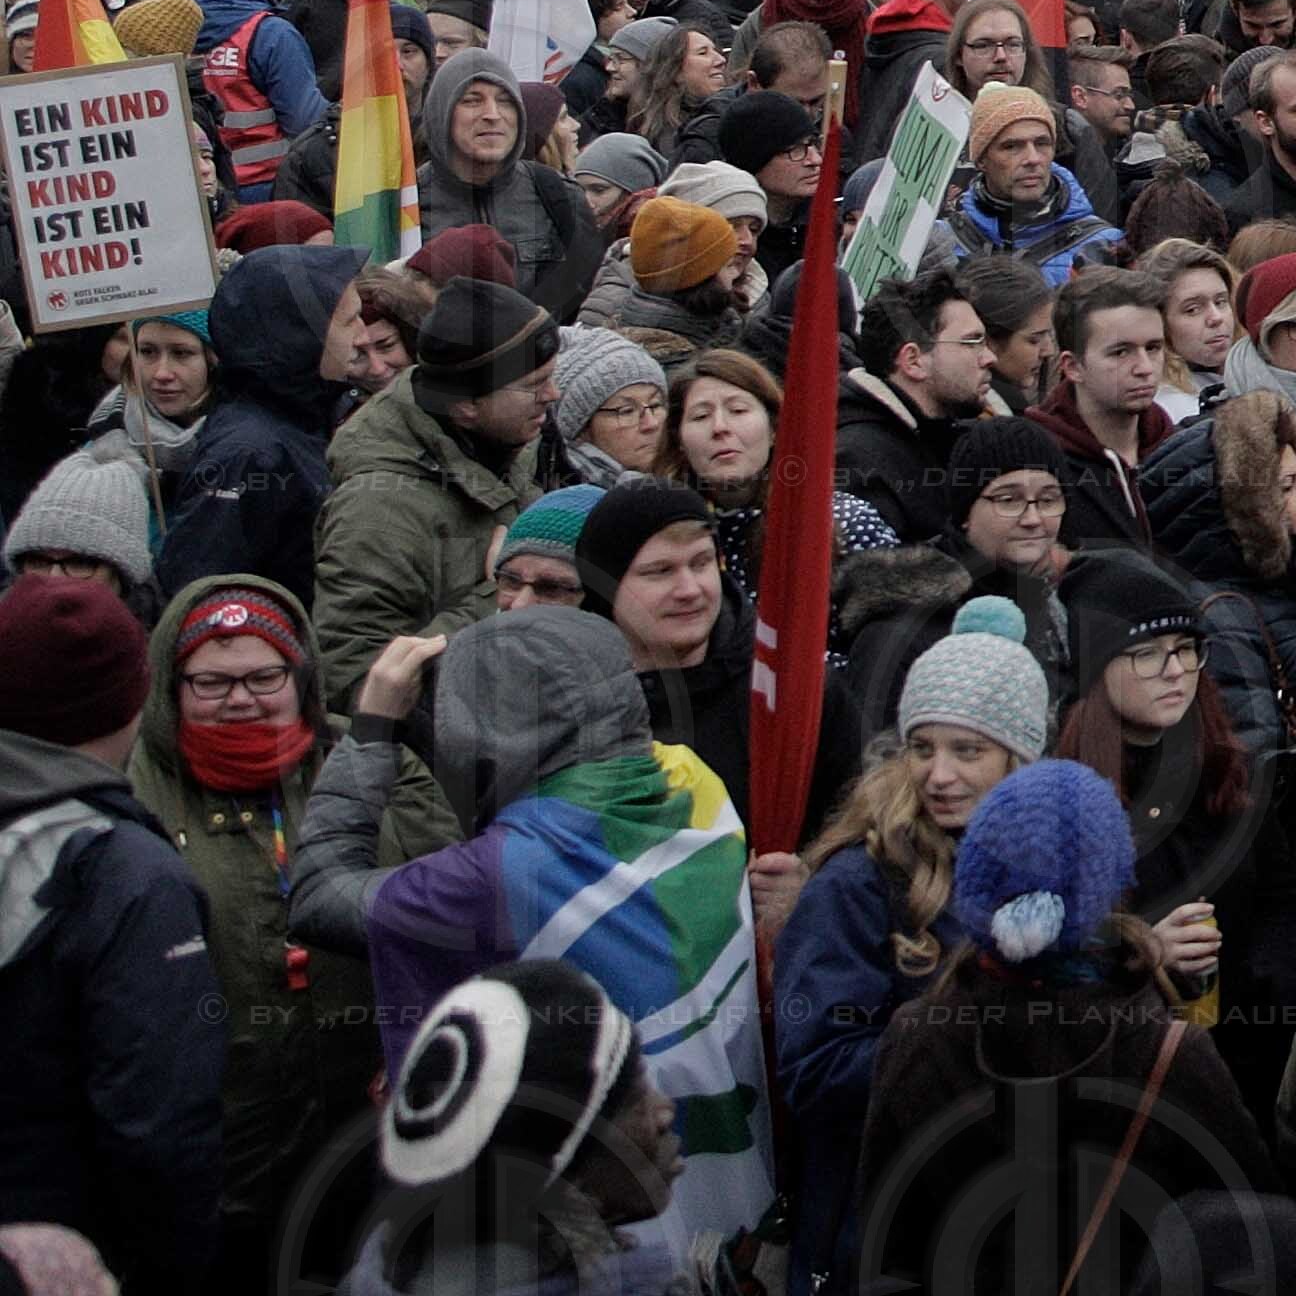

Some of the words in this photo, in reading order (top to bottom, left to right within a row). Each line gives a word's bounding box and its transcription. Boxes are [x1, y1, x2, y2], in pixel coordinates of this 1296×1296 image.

[14, 101, 73, 138] EIN
[80, 88, 170, 129] KIND
[20, 139, 71, 173] IST
[79, 129, 137, 165] EIN
[26, 169, 117, 209] KIND
[33, 209, 85, 244] IST
[91, 200, 150, 236] EIN
[39, 237, 144, 280] KIND!
